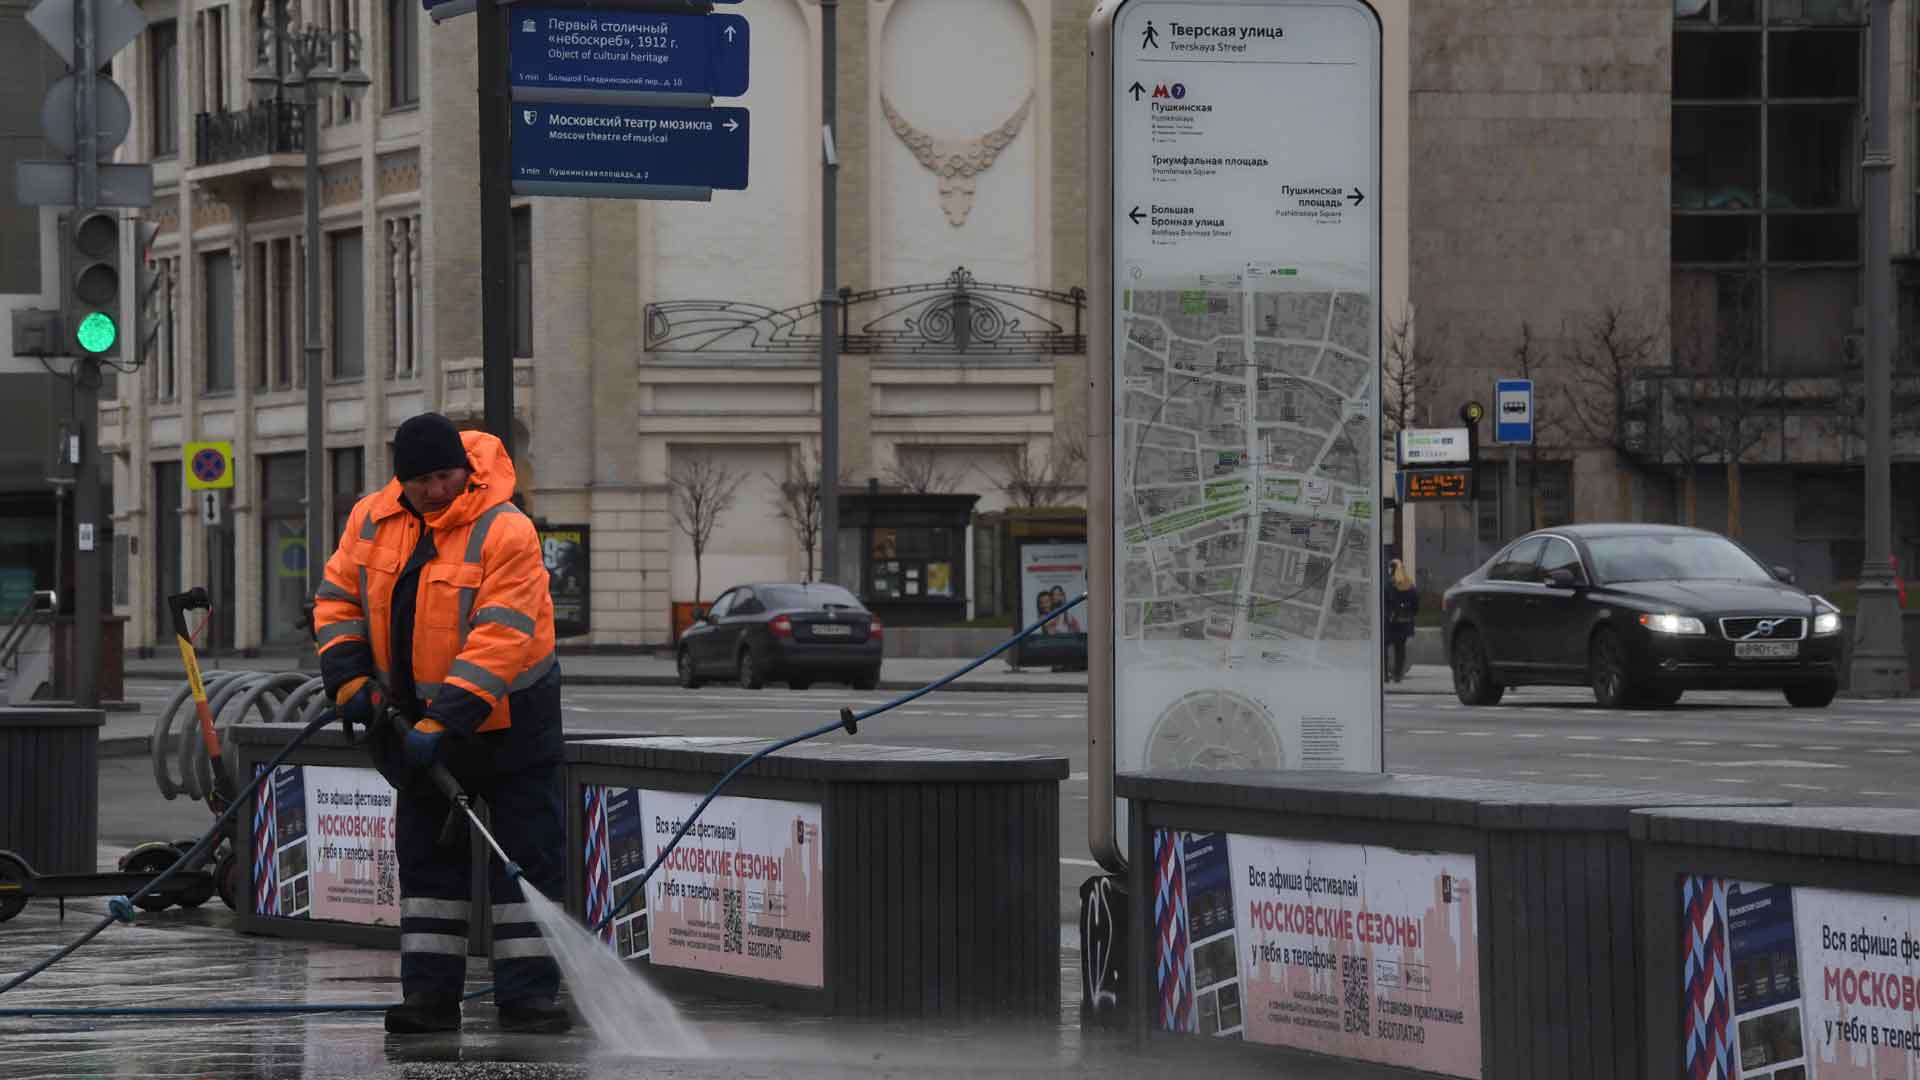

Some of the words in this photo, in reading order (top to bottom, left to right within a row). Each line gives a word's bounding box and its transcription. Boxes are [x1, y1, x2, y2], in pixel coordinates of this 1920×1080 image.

[548, 18, 598, 33] Первый
[601, 21, 668, 34] столичный
[1169, 22, 1236, 39] Тверская
[1240, 24, 1284, 40] улица
[548, 33, 634, 48] «небоскреб»,
[638, 36, 667, 48] 1912
[670, 39, 679, 49] г.
[1170, 41, 1215, 53] Tverskaya
[1217, 42, 1247, 52] Street
[548, 49, 578, 61] Object
[581, 50, 591, 60] of
[593, 50, 629, 61] cultural
[630, 51, 669, 64] heritage
[1151, 102, 1212, 113] Пушкинская
[549, 114, 622, 128] Московский
[624, 119, 657, 131] театр
[659, 118, 713, 131] мюзикла
[549, 130, 585, 140] Moscow
[586, 132, 621, 142] theatre
[622, 132, 632, 142] of
[633, 132, 668, 143] musical
[1151, 155, 1222, 167] Триумфальная
[1225, 157, 1269, 167] площадь
[1281, 185, 1343, 196] Пушкинская
[1151, 205, 1194, 215] Большая
[1298, 198, 1343, 209] площадь
[1151, 216, 1193, 228] Бронная
[1195, 218, 1225, 228] улица
[318, 815, 386, 838] МОСКОВСКИЕ
[655, 816, 669, 833] Вся
[697, 820, 737, 840] фестивалей
[734, 851, 782, 882] СЕЗОНЫ
[1249, 865, 1266, 888] Вся
[1269, 866, 1303, 894] афиша
[1304, 868, 1359, 897] фестивалей
[657, 881, 662, 898] у
[663, 878, 680, 897] тебя
[681, 884, 686, 897] в
[687, 881, 720, 902] телефоне
[1250, 900, 1353, 940] МОСКОВСКИЕ
[1356, 911, 1422, 949] СЕЗОНЫ
[1822, 924, 1847, 952] Вся
[1850, 926, 1898, 961] афиша
[1251, 945, 1257, 966] у
[1260, 940, 1282, 964] тебя
[1283, 949, 1290, 964] в
[1291, 945, 1337, 975] телефоне
[1823, 965, 1920, 1012] МОСКОВ
[1377, 1019, 1425, 1044] БЕСПЛАТНО
[1825, 1020, 1832, 1046] у
[1835, 1015, 1868, 1044] тебя
[1871, 1025, 1880, 1046] в
